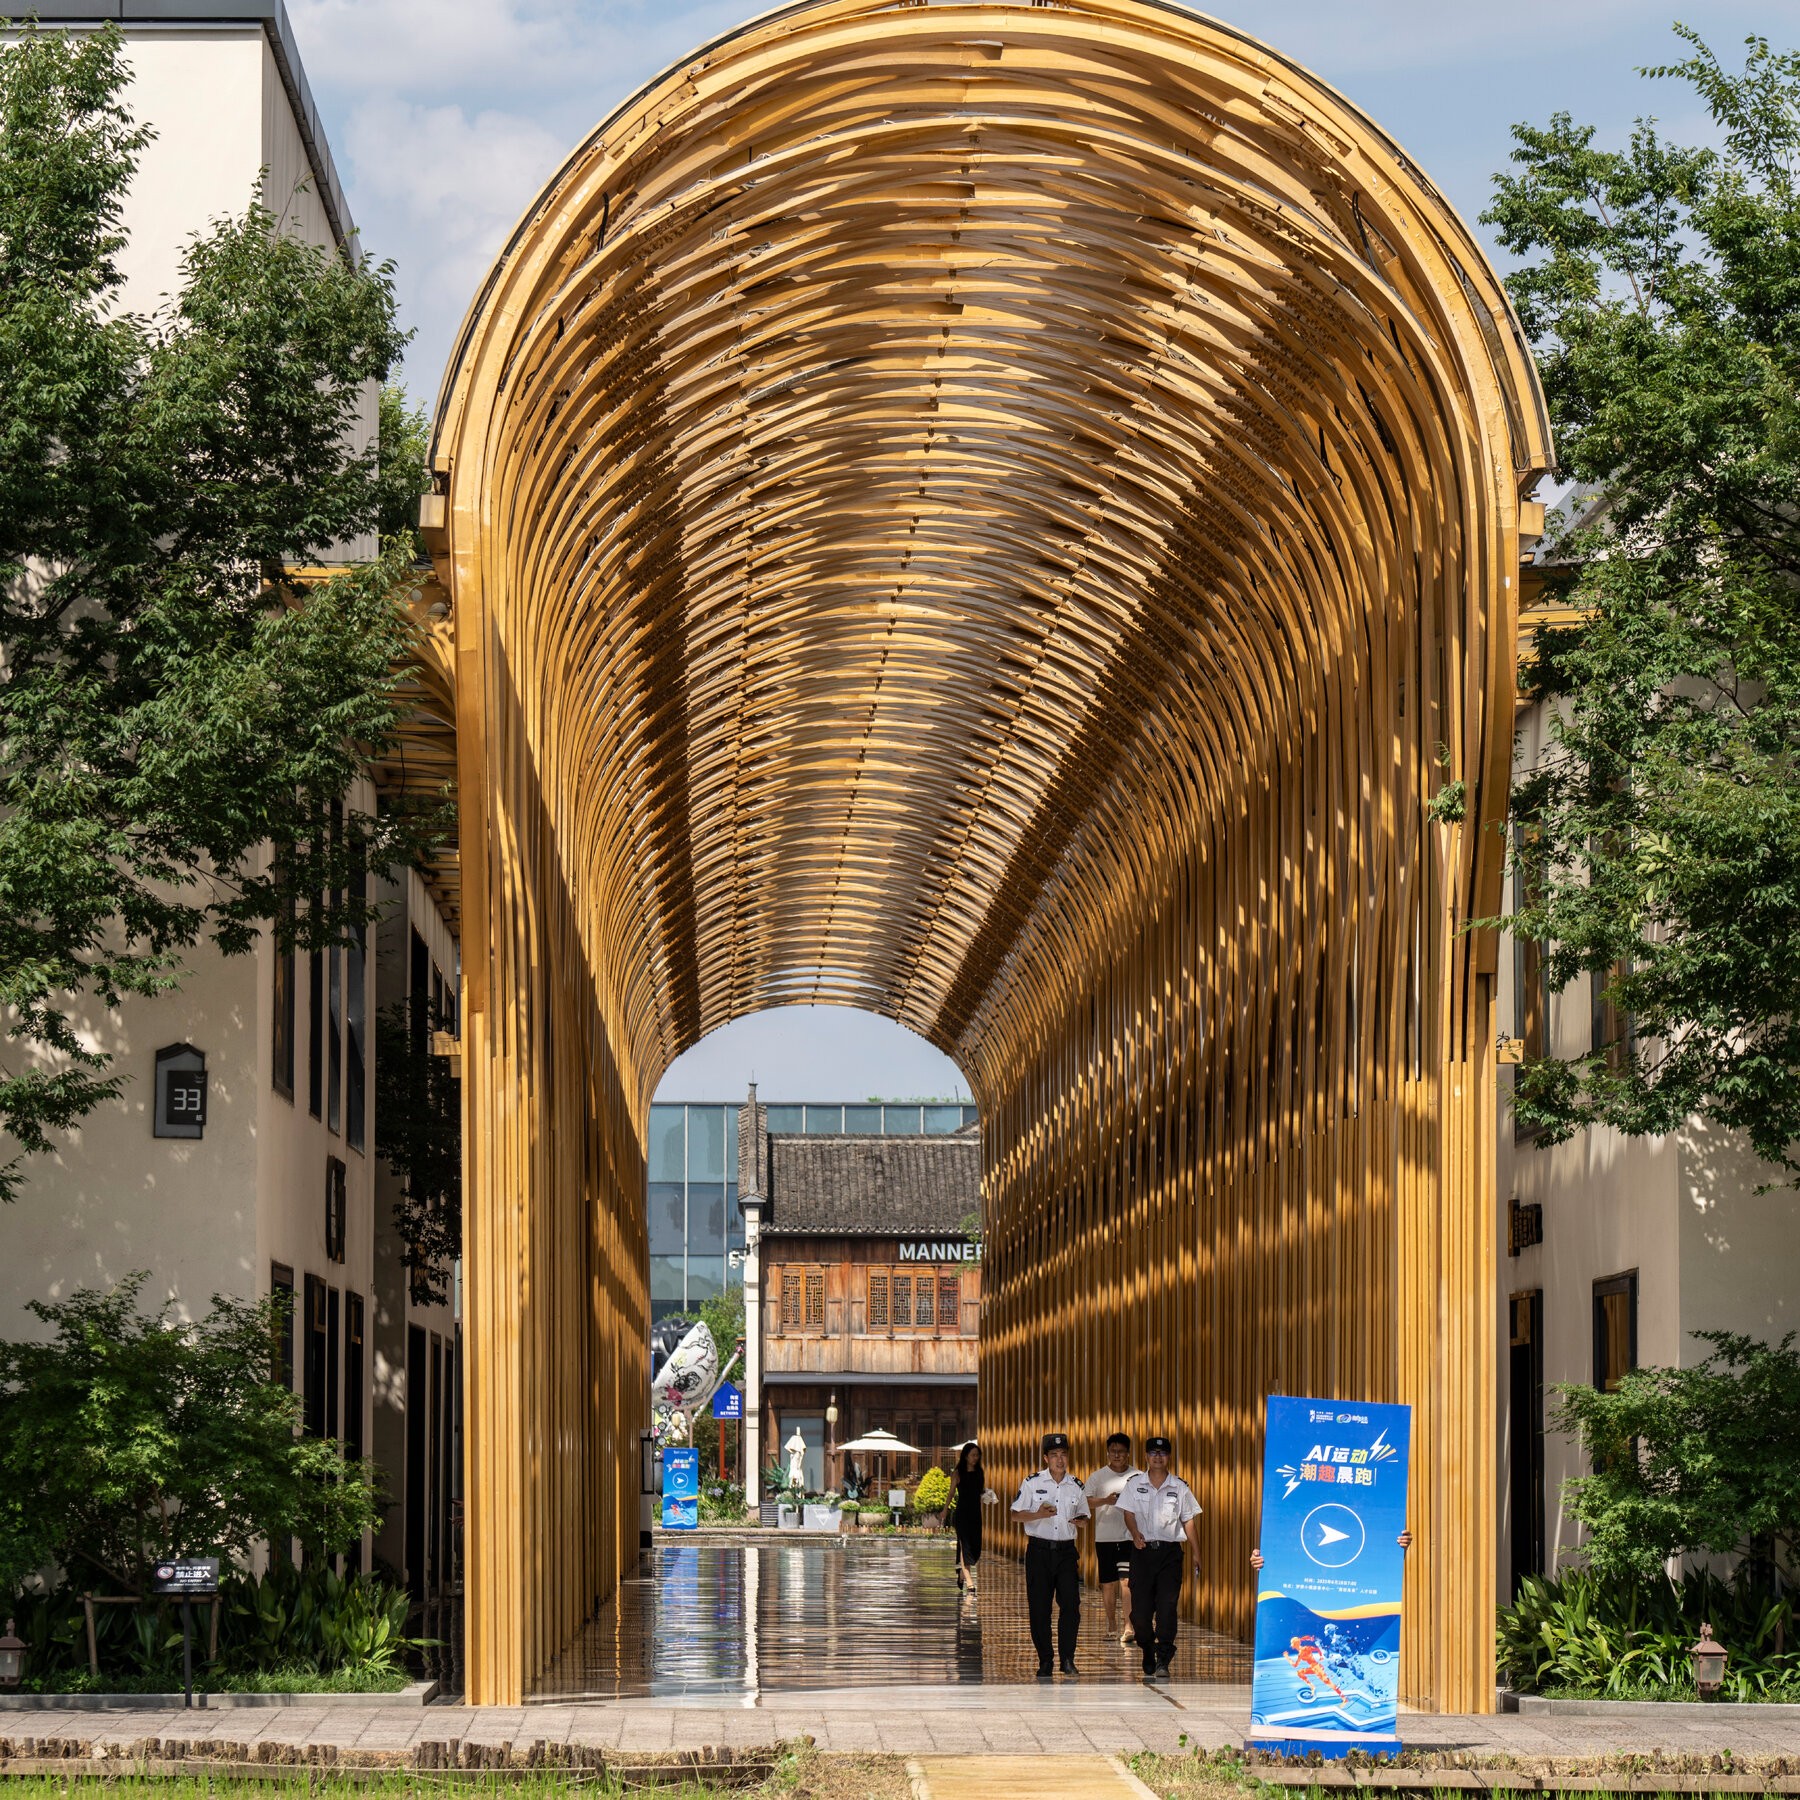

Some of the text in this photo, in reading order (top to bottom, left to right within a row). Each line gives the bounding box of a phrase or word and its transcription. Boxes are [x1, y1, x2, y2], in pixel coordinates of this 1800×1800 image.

[174, 1089, 200, 1110] 33
[1302, 1445, 1369, 1464] AI运动
[1299, 1463, 1372, 1486] 潮趣晨跑
[175, 1570, 211, 1578] 禁止进入
